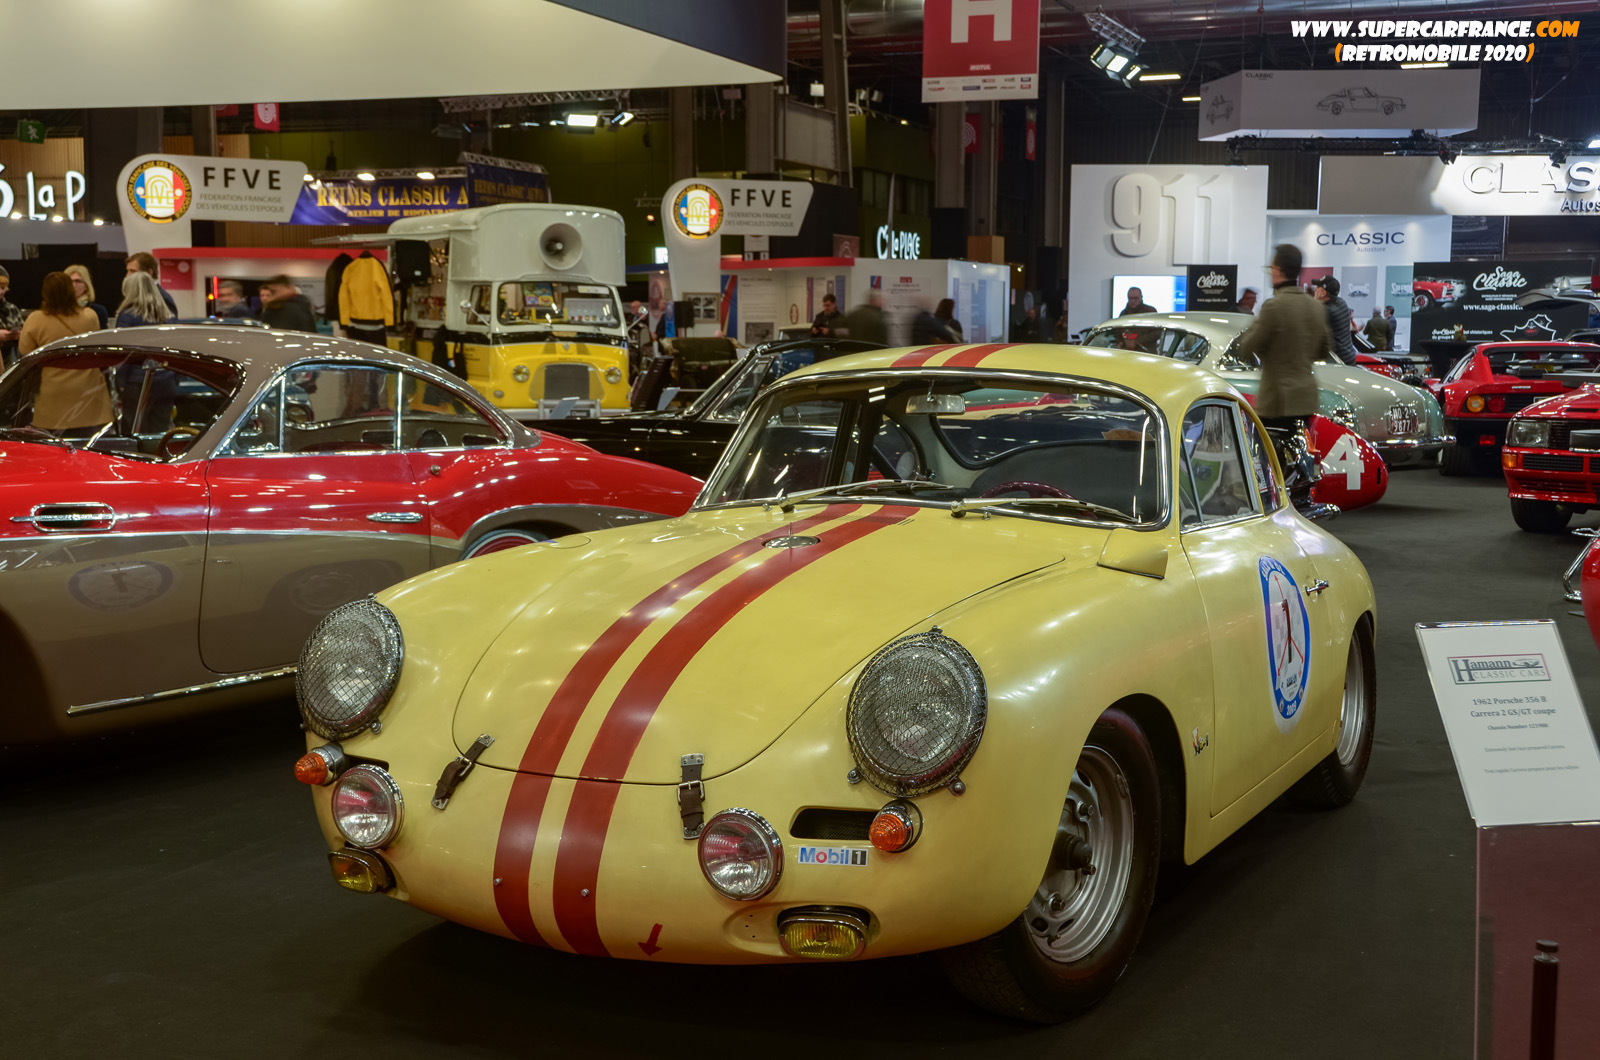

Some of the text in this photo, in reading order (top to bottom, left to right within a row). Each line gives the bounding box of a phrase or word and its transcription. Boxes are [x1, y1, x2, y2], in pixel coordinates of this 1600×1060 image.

[203, 167, 281, 190] FFVE
[1462, 161, 1600, 195] CLAS
[316, 185, 372, 207] REIMS
[377, 185, 451, 206] CLASSIC
[730, 189, 792, 208] FFVE
[1110, 172, 1232, 267] 911
[1316, 232, 1405, 246] CLASSIC
[1472, 272, 1527, 291] Classic
[1494, 266, 1521, 282] Saga
[1463, 303, 1524, 312] www.saga-classic.
[1322, 433, 1365, 491] 4
[1451, 659, 1512, 682] Hamann
[1473, 669, 1546, 679] CLASSIC CARS
[1472, 698, 1492, 706] 1962
[1493, 697, 1523, 705] Porsche
[1470, 710, 1500, 718] Carrera
[1507, 708, 1532, 717] GS/GT
[1533, 707, 1556, 716] coupe
[799, 847, 850, 865] Mobil
